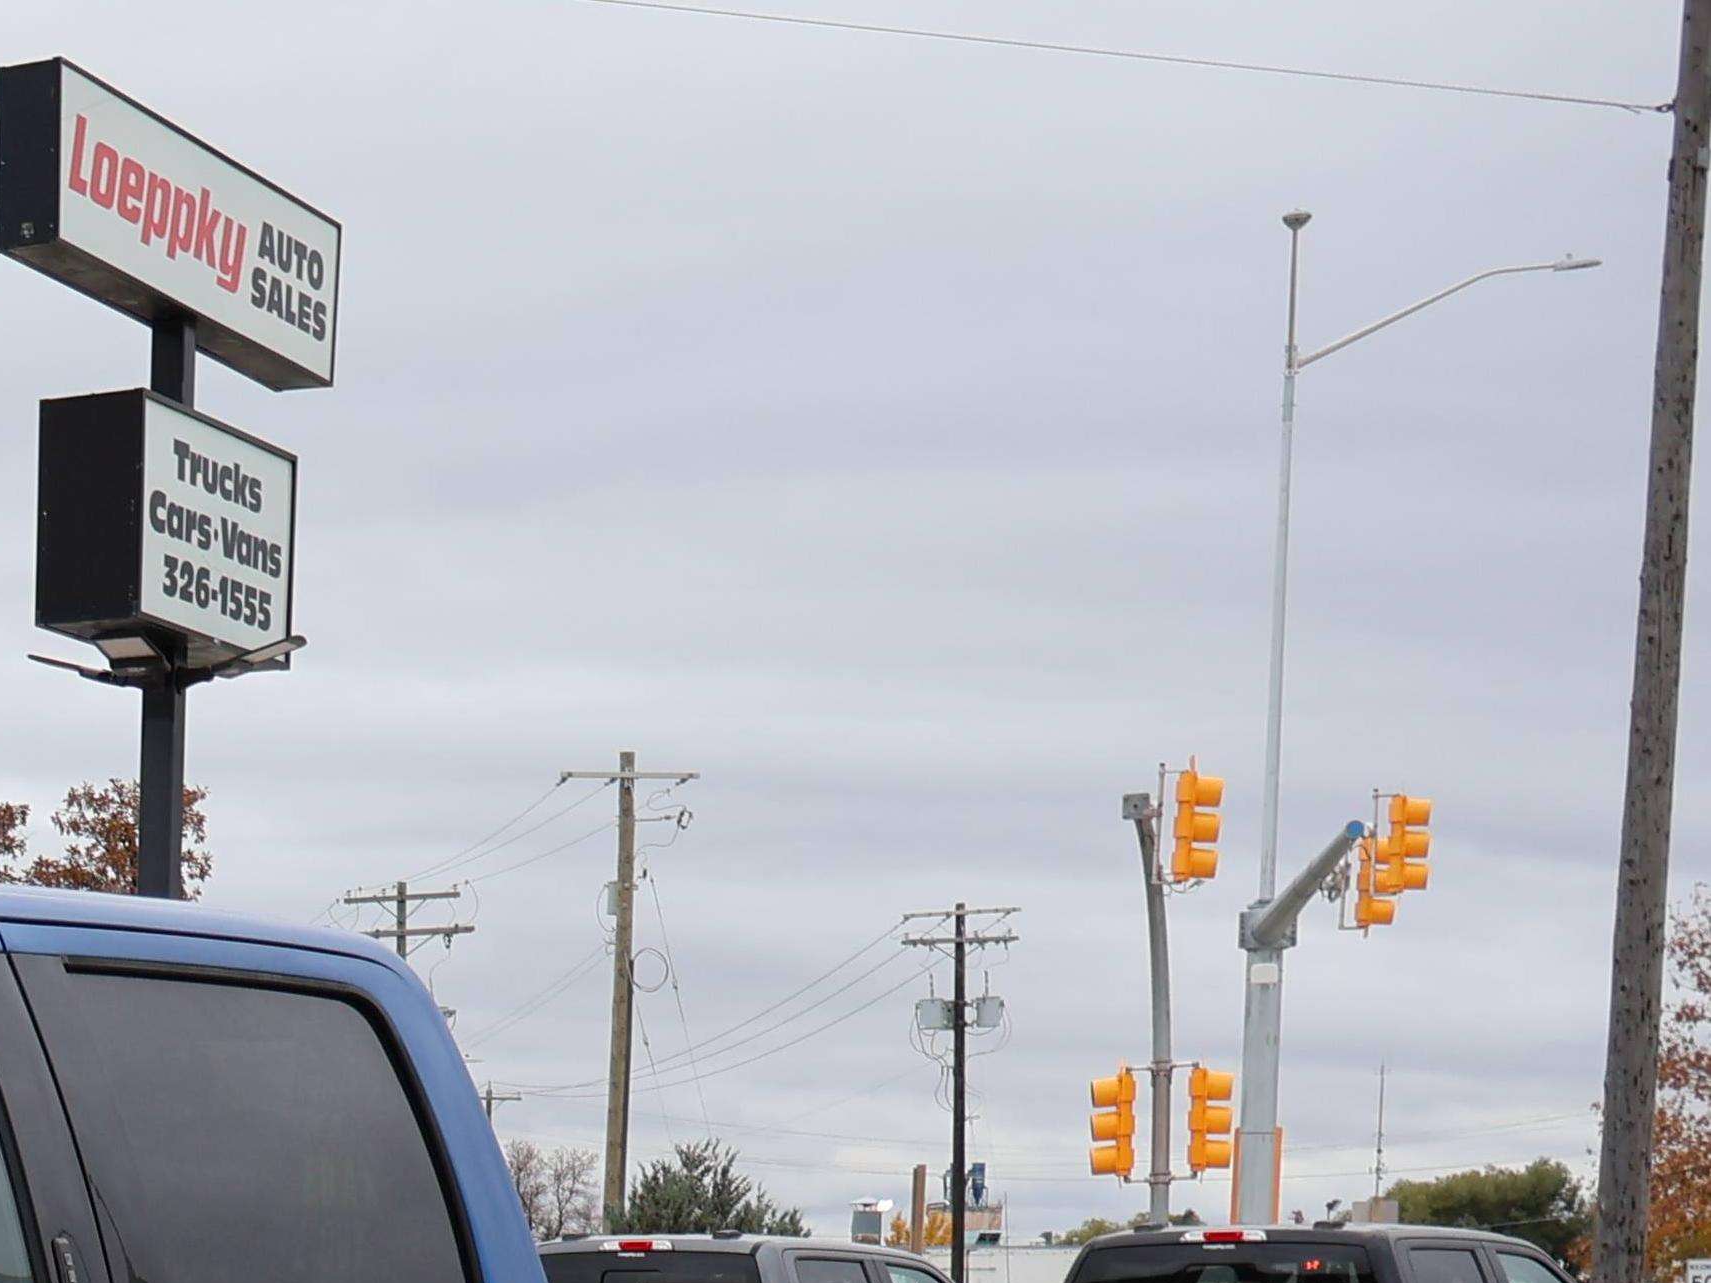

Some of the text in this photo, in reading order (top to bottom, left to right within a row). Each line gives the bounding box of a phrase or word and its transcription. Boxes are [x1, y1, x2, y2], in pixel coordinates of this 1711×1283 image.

[69, 113, 247, 293] Loeppky
[258, 221, 323, 290] AUTO
[251, 267, 327, 341] SALES
[173, 438, 262, 513] Trucks
[163, 554, 271, 631] 326-1555
